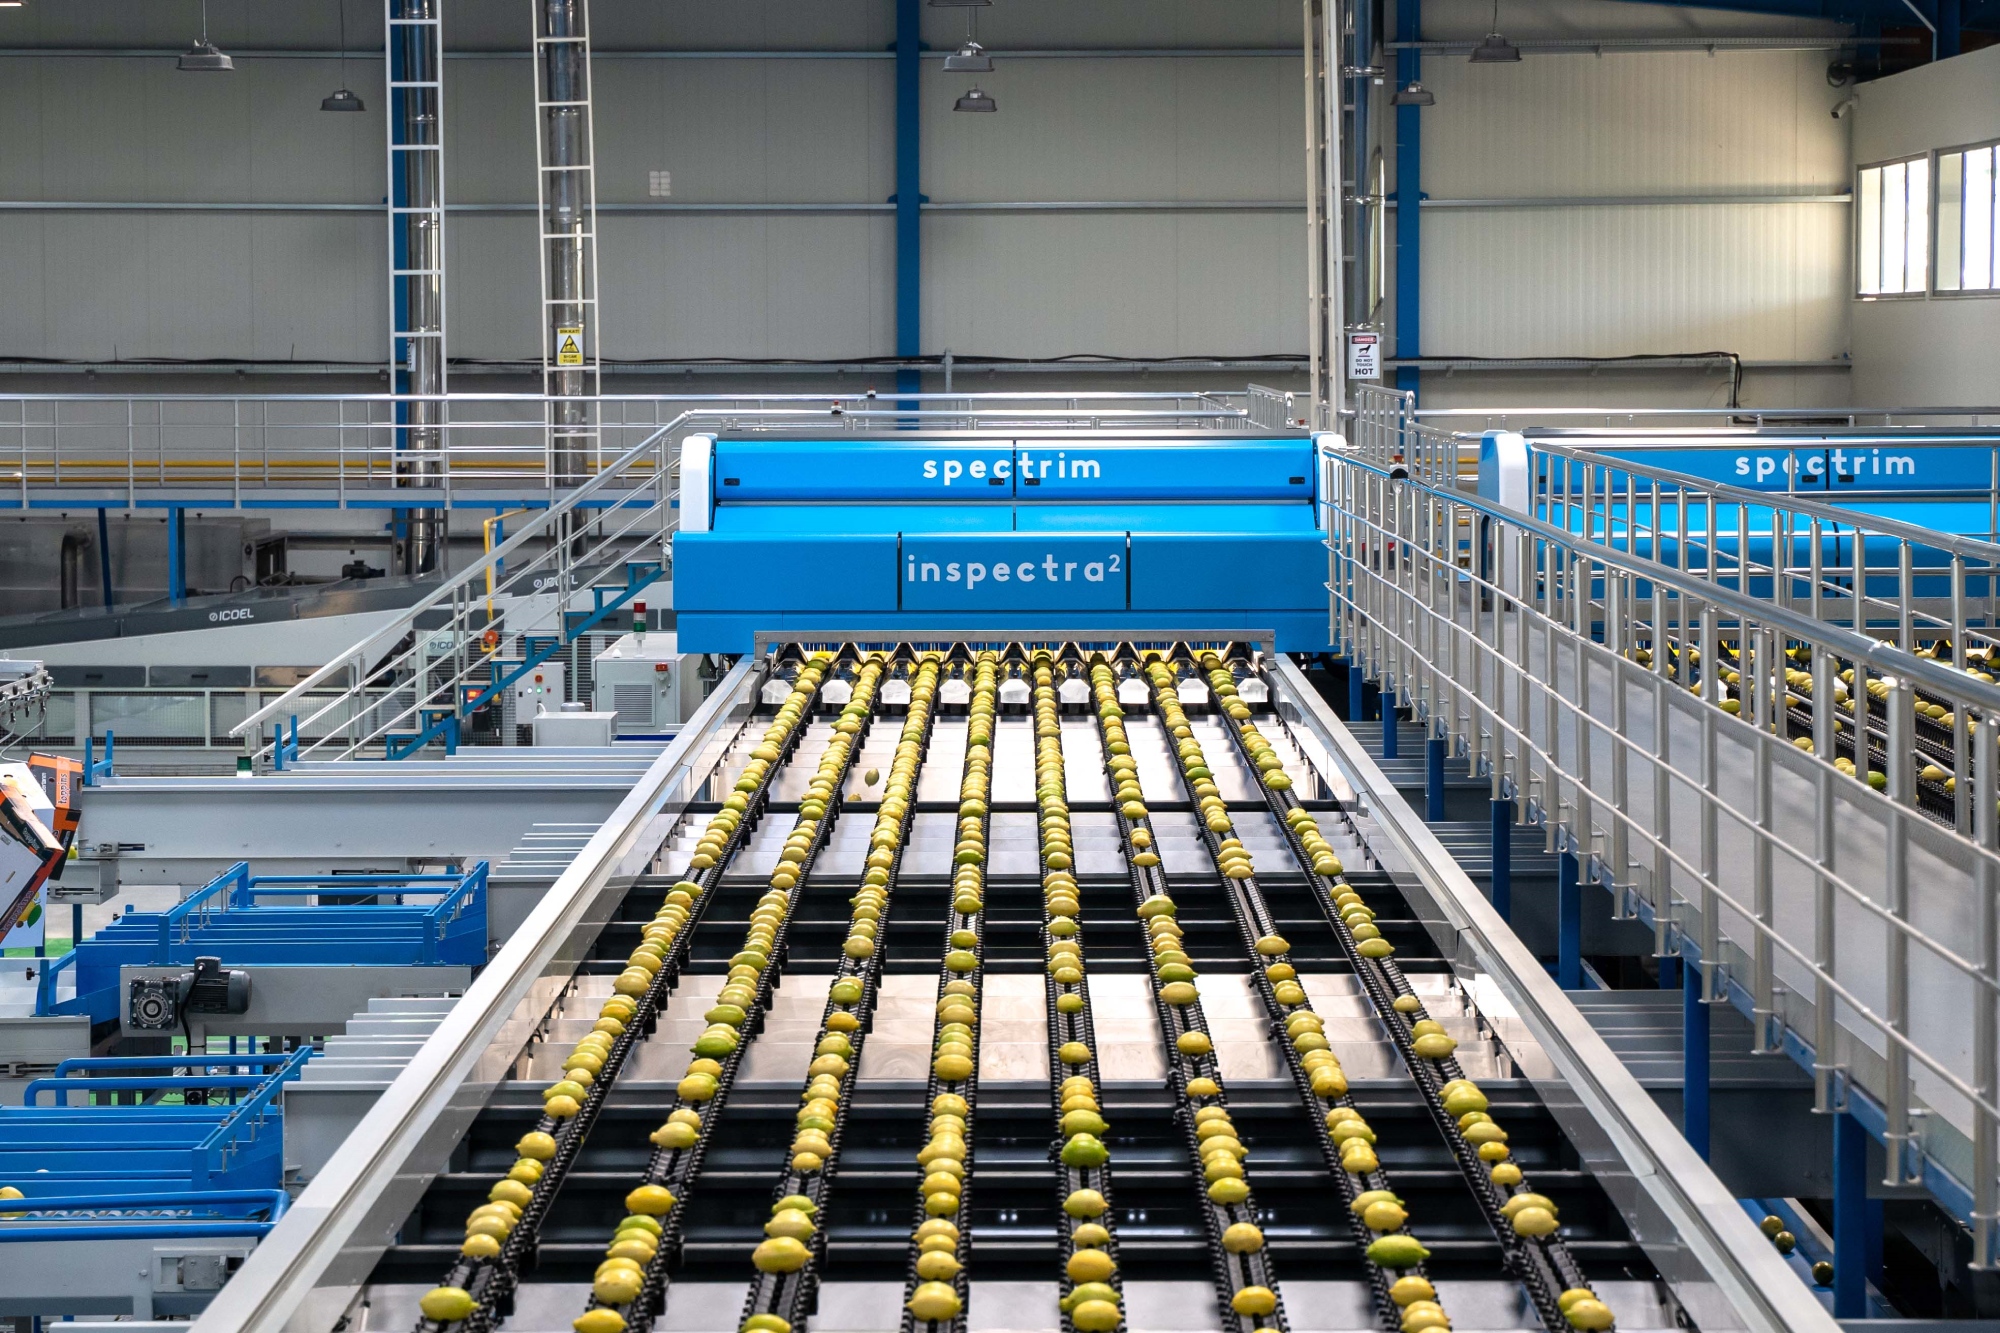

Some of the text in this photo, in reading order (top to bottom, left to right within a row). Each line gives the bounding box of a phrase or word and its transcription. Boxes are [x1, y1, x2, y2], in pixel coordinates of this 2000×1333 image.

[923, 452, 1101, 486] spectrim
[1735, 448, 1915, 482] spectrim
[219, 608, 254, 621] ICOEL
[57, 773, 70, 805] toppins
